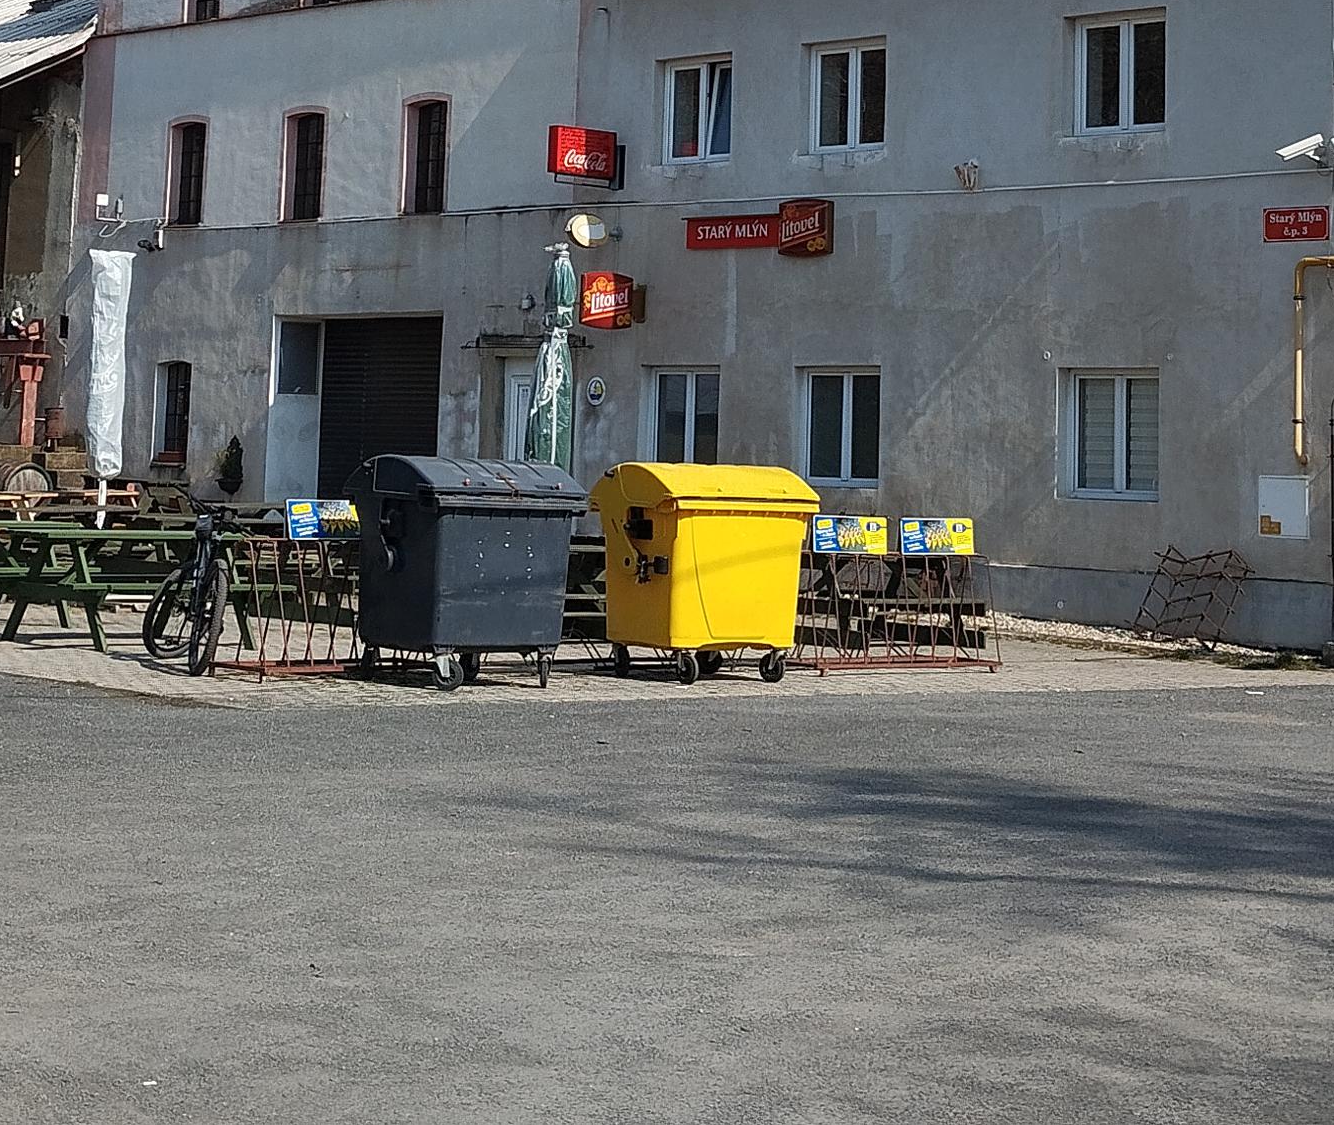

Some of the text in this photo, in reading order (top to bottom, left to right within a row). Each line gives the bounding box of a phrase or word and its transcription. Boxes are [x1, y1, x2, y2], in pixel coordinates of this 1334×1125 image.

[696, 219, 769, 240] STARÝ MLÝN
[781, 211, 820, 243] Litovel
[1269, 211, 1323, 225] Starý Mlýn
[590, 288, 629, 314] Litovel
